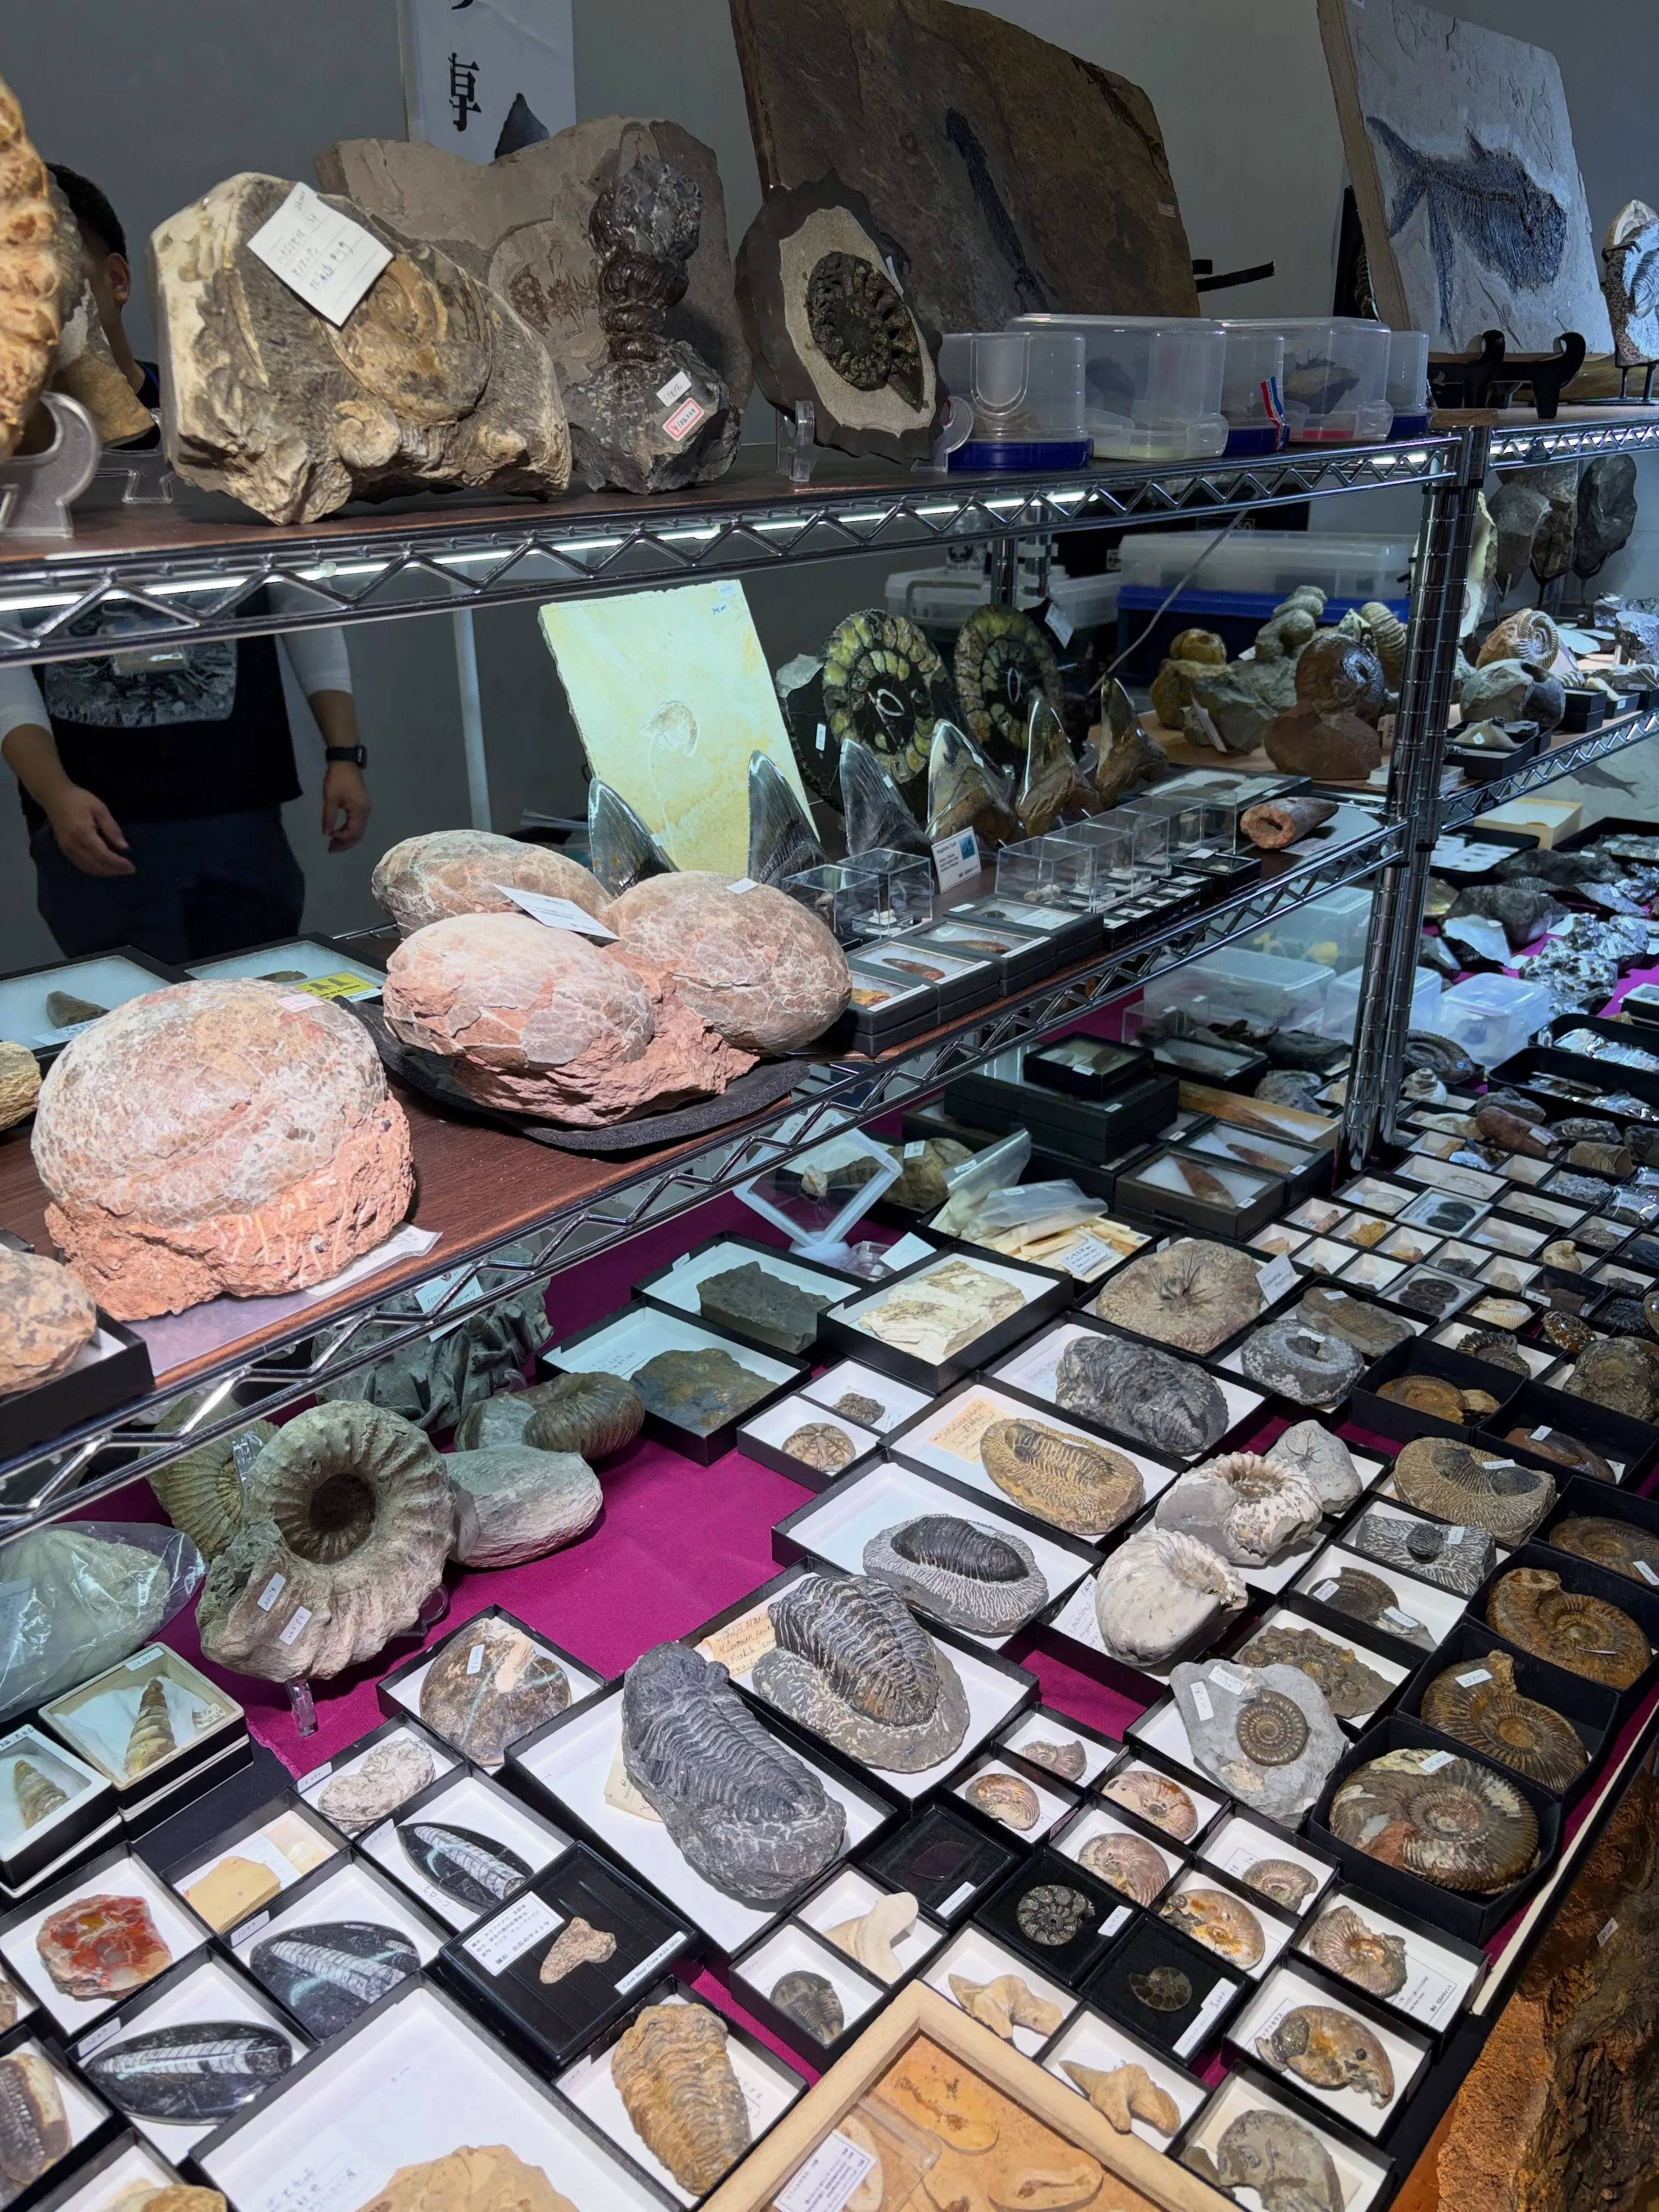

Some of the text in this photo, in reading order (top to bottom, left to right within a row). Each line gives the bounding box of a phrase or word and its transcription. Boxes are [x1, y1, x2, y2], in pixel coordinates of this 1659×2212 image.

[622, 1976, 635, 1988] Cave
[635, 1966, 647, 1977] Bear
[646, 1955, 659, 1967] Claw
